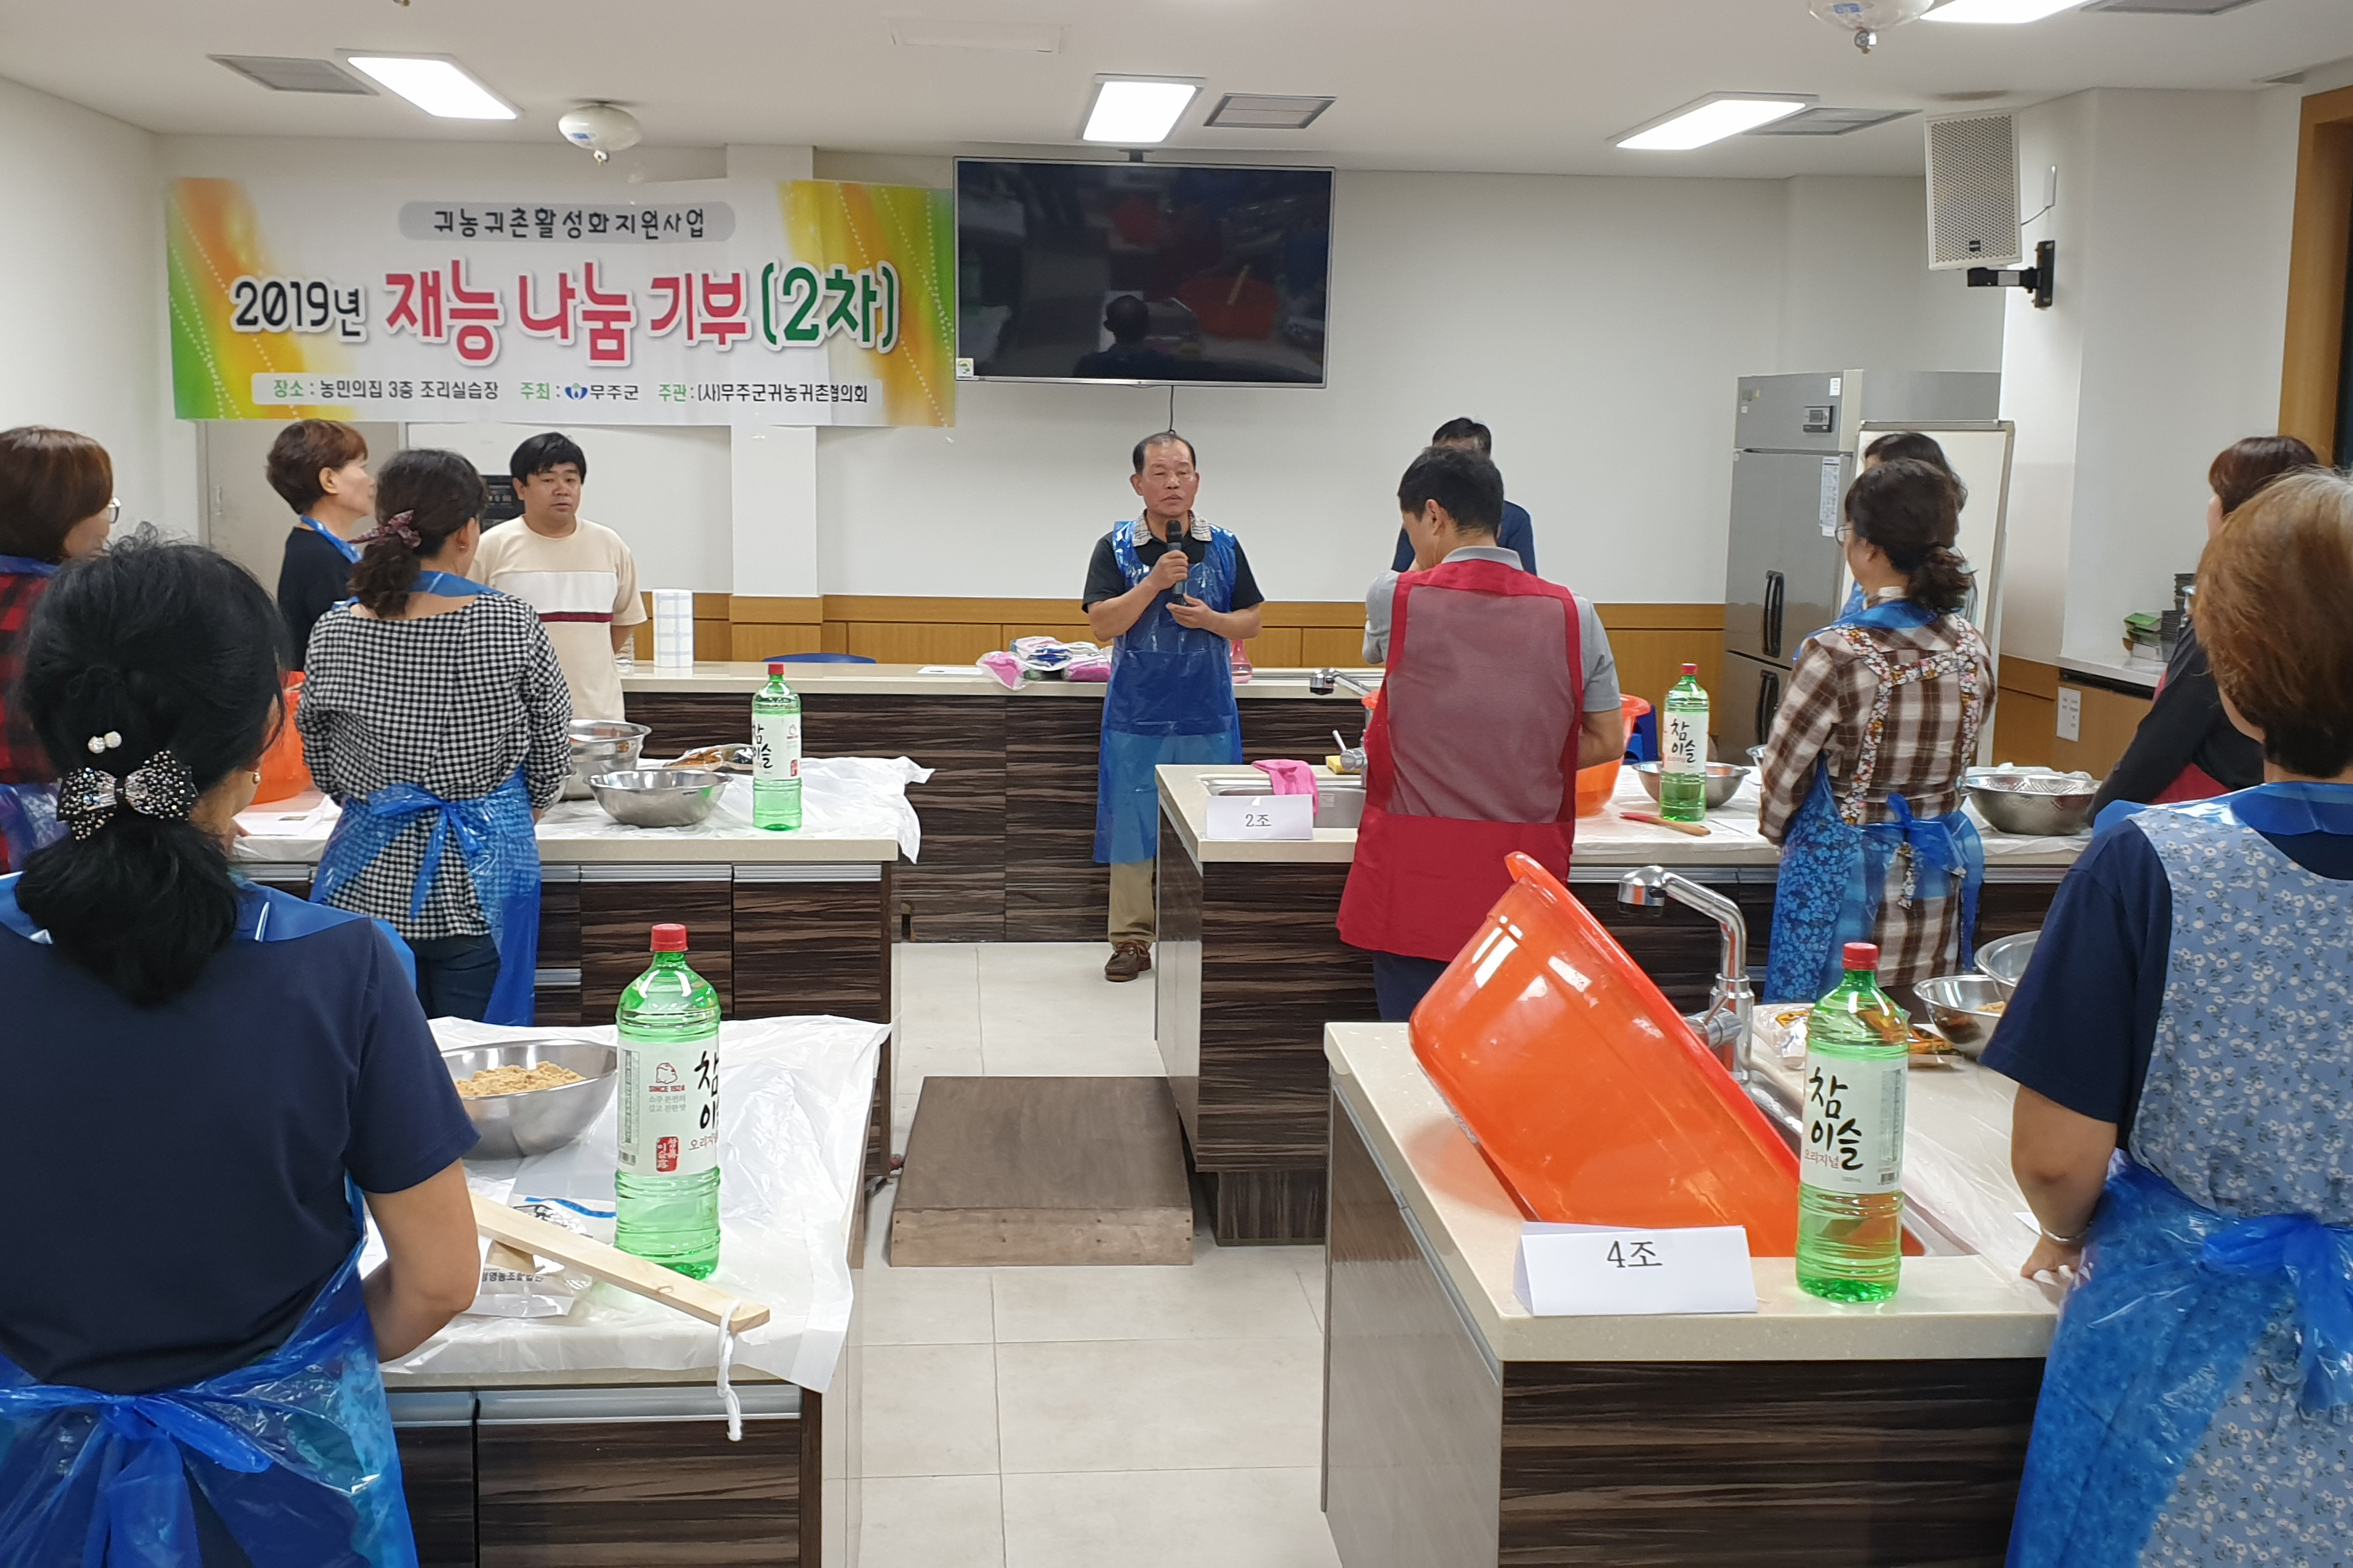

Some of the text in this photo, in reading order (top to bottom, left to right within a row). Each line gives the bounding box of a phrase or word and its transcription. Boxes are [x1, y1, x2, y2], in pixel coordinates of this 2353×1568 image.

[433, 207, 705, 240] 귀농귀촌활성화지원사업
[234, 280, 362, 337] 2019년
[384, 259, 500, 361] 재능
[518, 261, 632, 362] 나눔
[320, 379, 383, 399] 농민의집
[388, 381, 413, 399] 3층
[420, 381, 499, 400] 조리실습장
[590, 384, 639, 401] 무주군
[1245, 813, 1272, 827] 2조
[1606, 1240, 1663, 1268] 4조
